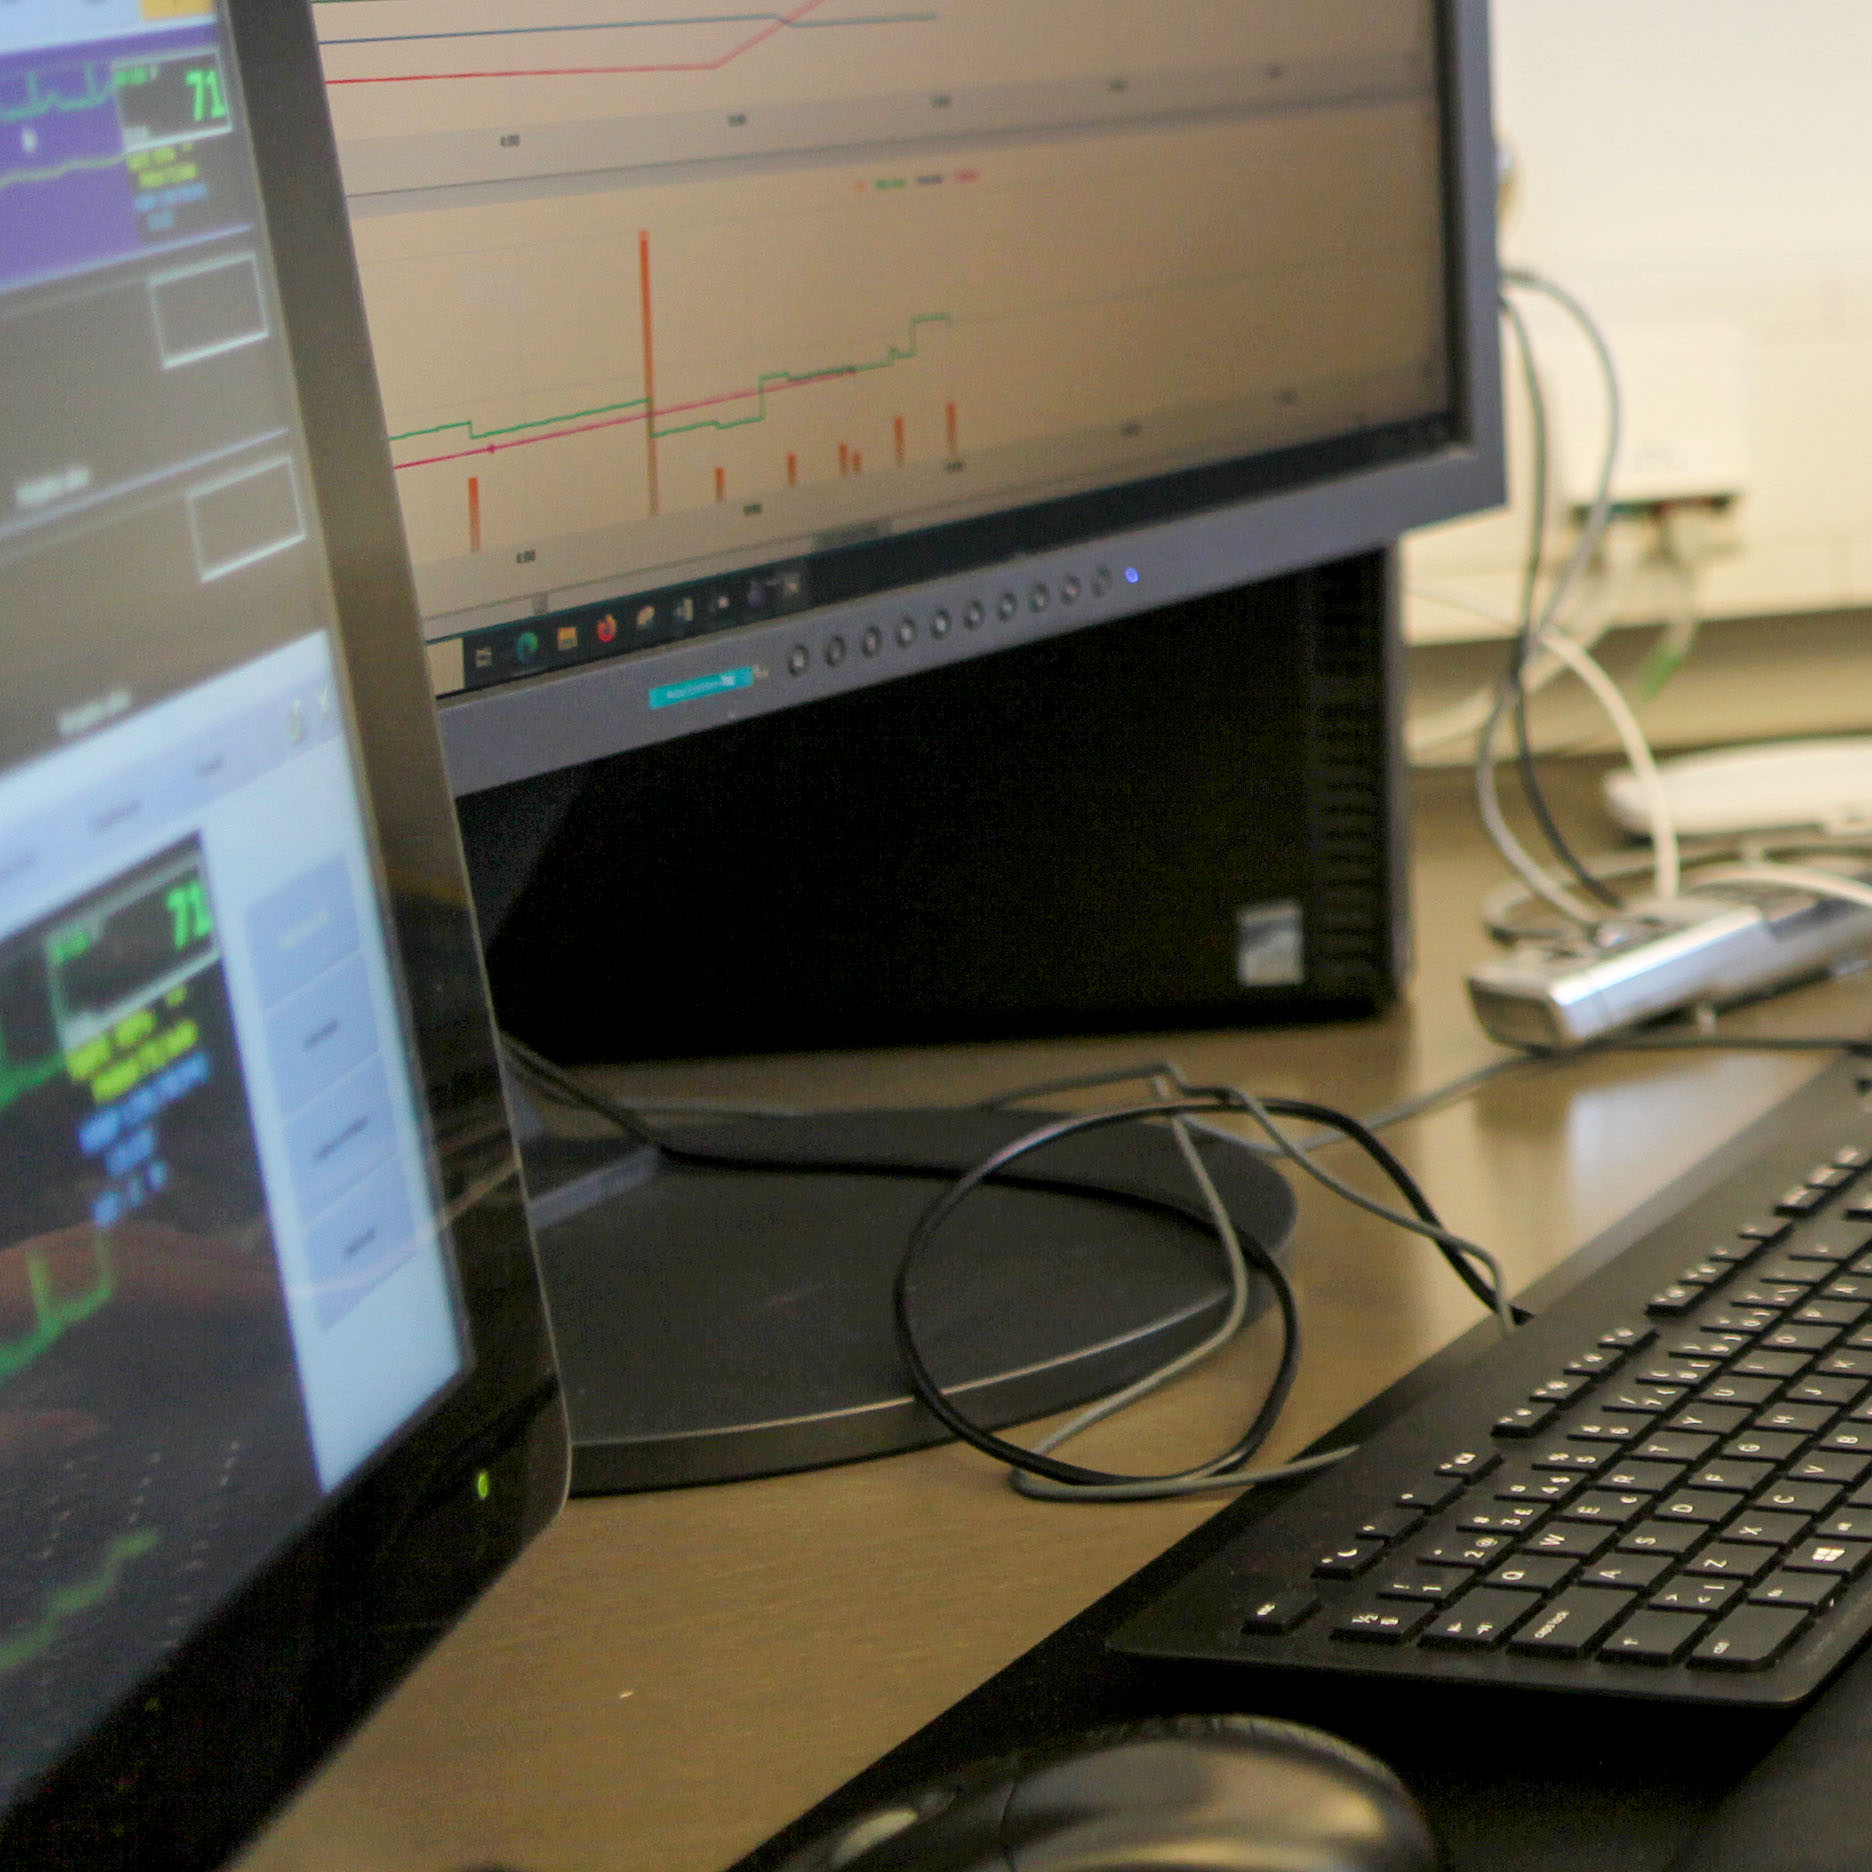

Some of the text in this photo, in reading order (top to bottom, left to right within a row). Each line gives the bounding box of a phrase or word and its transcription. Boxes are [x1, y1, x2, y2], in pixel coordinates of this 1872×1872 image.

[185, 68, 227, 122] 71
[1772, 1332, 1797, 1343] O
[1711, 1387, 1735, 1396] U
[1802, 1387, 1822, 1395] J
[1681, 1415, 1702, 1424] Y
[1772, 1415, 1795, 1423] H
[1836, 1435, 1858, 1444] B
[1647, 1444, 1670, 1452] T
[1738, 1443, 1760, 1452] G
[1803, 1464, 1825, 1473] V
[1611, 1475, 1635, 1483] R
[1704, 1473, 1724, 1482] F
[1772, 1495, 1794, 1503] C
[1576, 1505, 1600, 1515] E
[1671, 1504, 1693, 1513] D
[1739, 1526, 1762, 1535] X
[1539, 1534, 1565, 1546] W
[1634, 1536, 1656, 1545] S
[1463, 1550, 1484, 1558] 2
[1703, 1559, 1727, 1568] Z
[1501, 1570, 1525, 1580] Q
[1599, 1569, 1621, 1579] A
